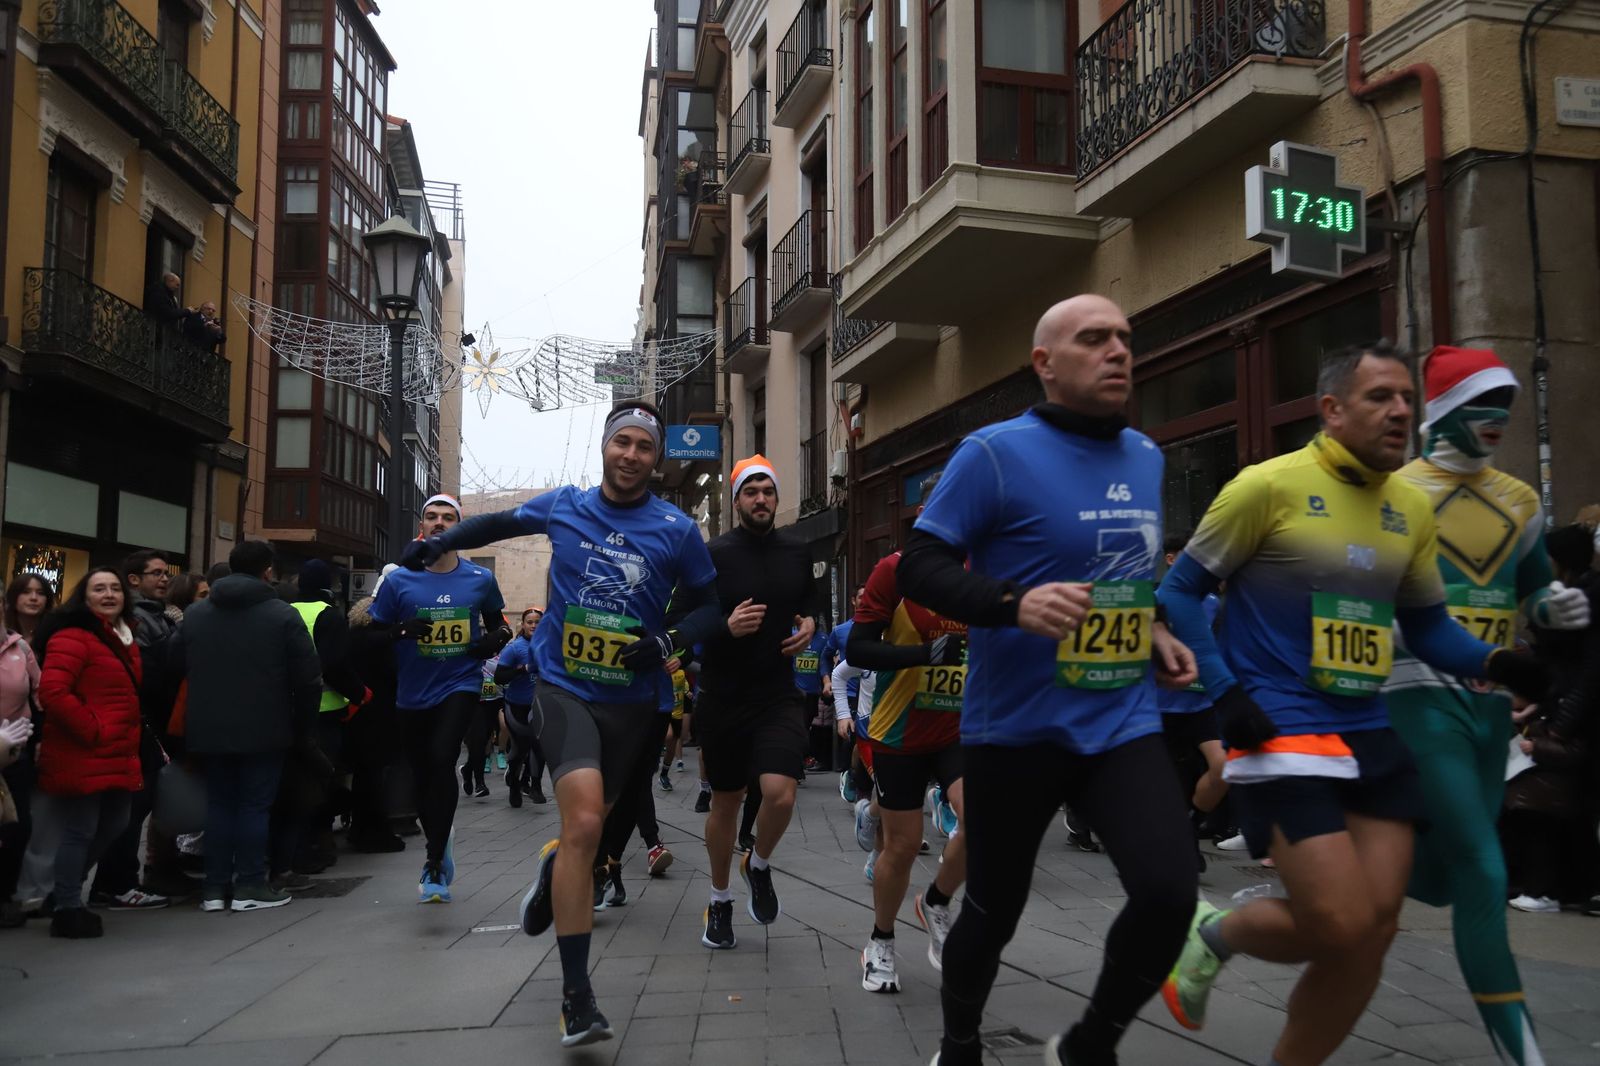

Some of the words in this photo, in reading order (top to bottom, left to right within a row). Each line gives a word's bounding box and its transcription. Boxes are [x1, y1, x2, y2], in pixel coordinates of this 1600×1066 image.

[1271, 188, 1353, 232] 17:30
[669, 448, 716, 457] Samsonite
[1106, 483, 1132, 502] 46
[605, 532, 625, 546] 46
[580, 541, 593, 550] SAN
[594, 545, 628, 560] SILVESTRE
[436, 594, 451, 604] 46
[1074, 612, 1141, 654] 1243
[568, 631, 628, 666] 937
[1323, 623, 1379, 667] 1105
[579, 666, 600, 676] CAJA
[601, 671, 629, 681] RURAL
[797, 659, 816, 669] 707
[925, 667, 968, 696] 126
